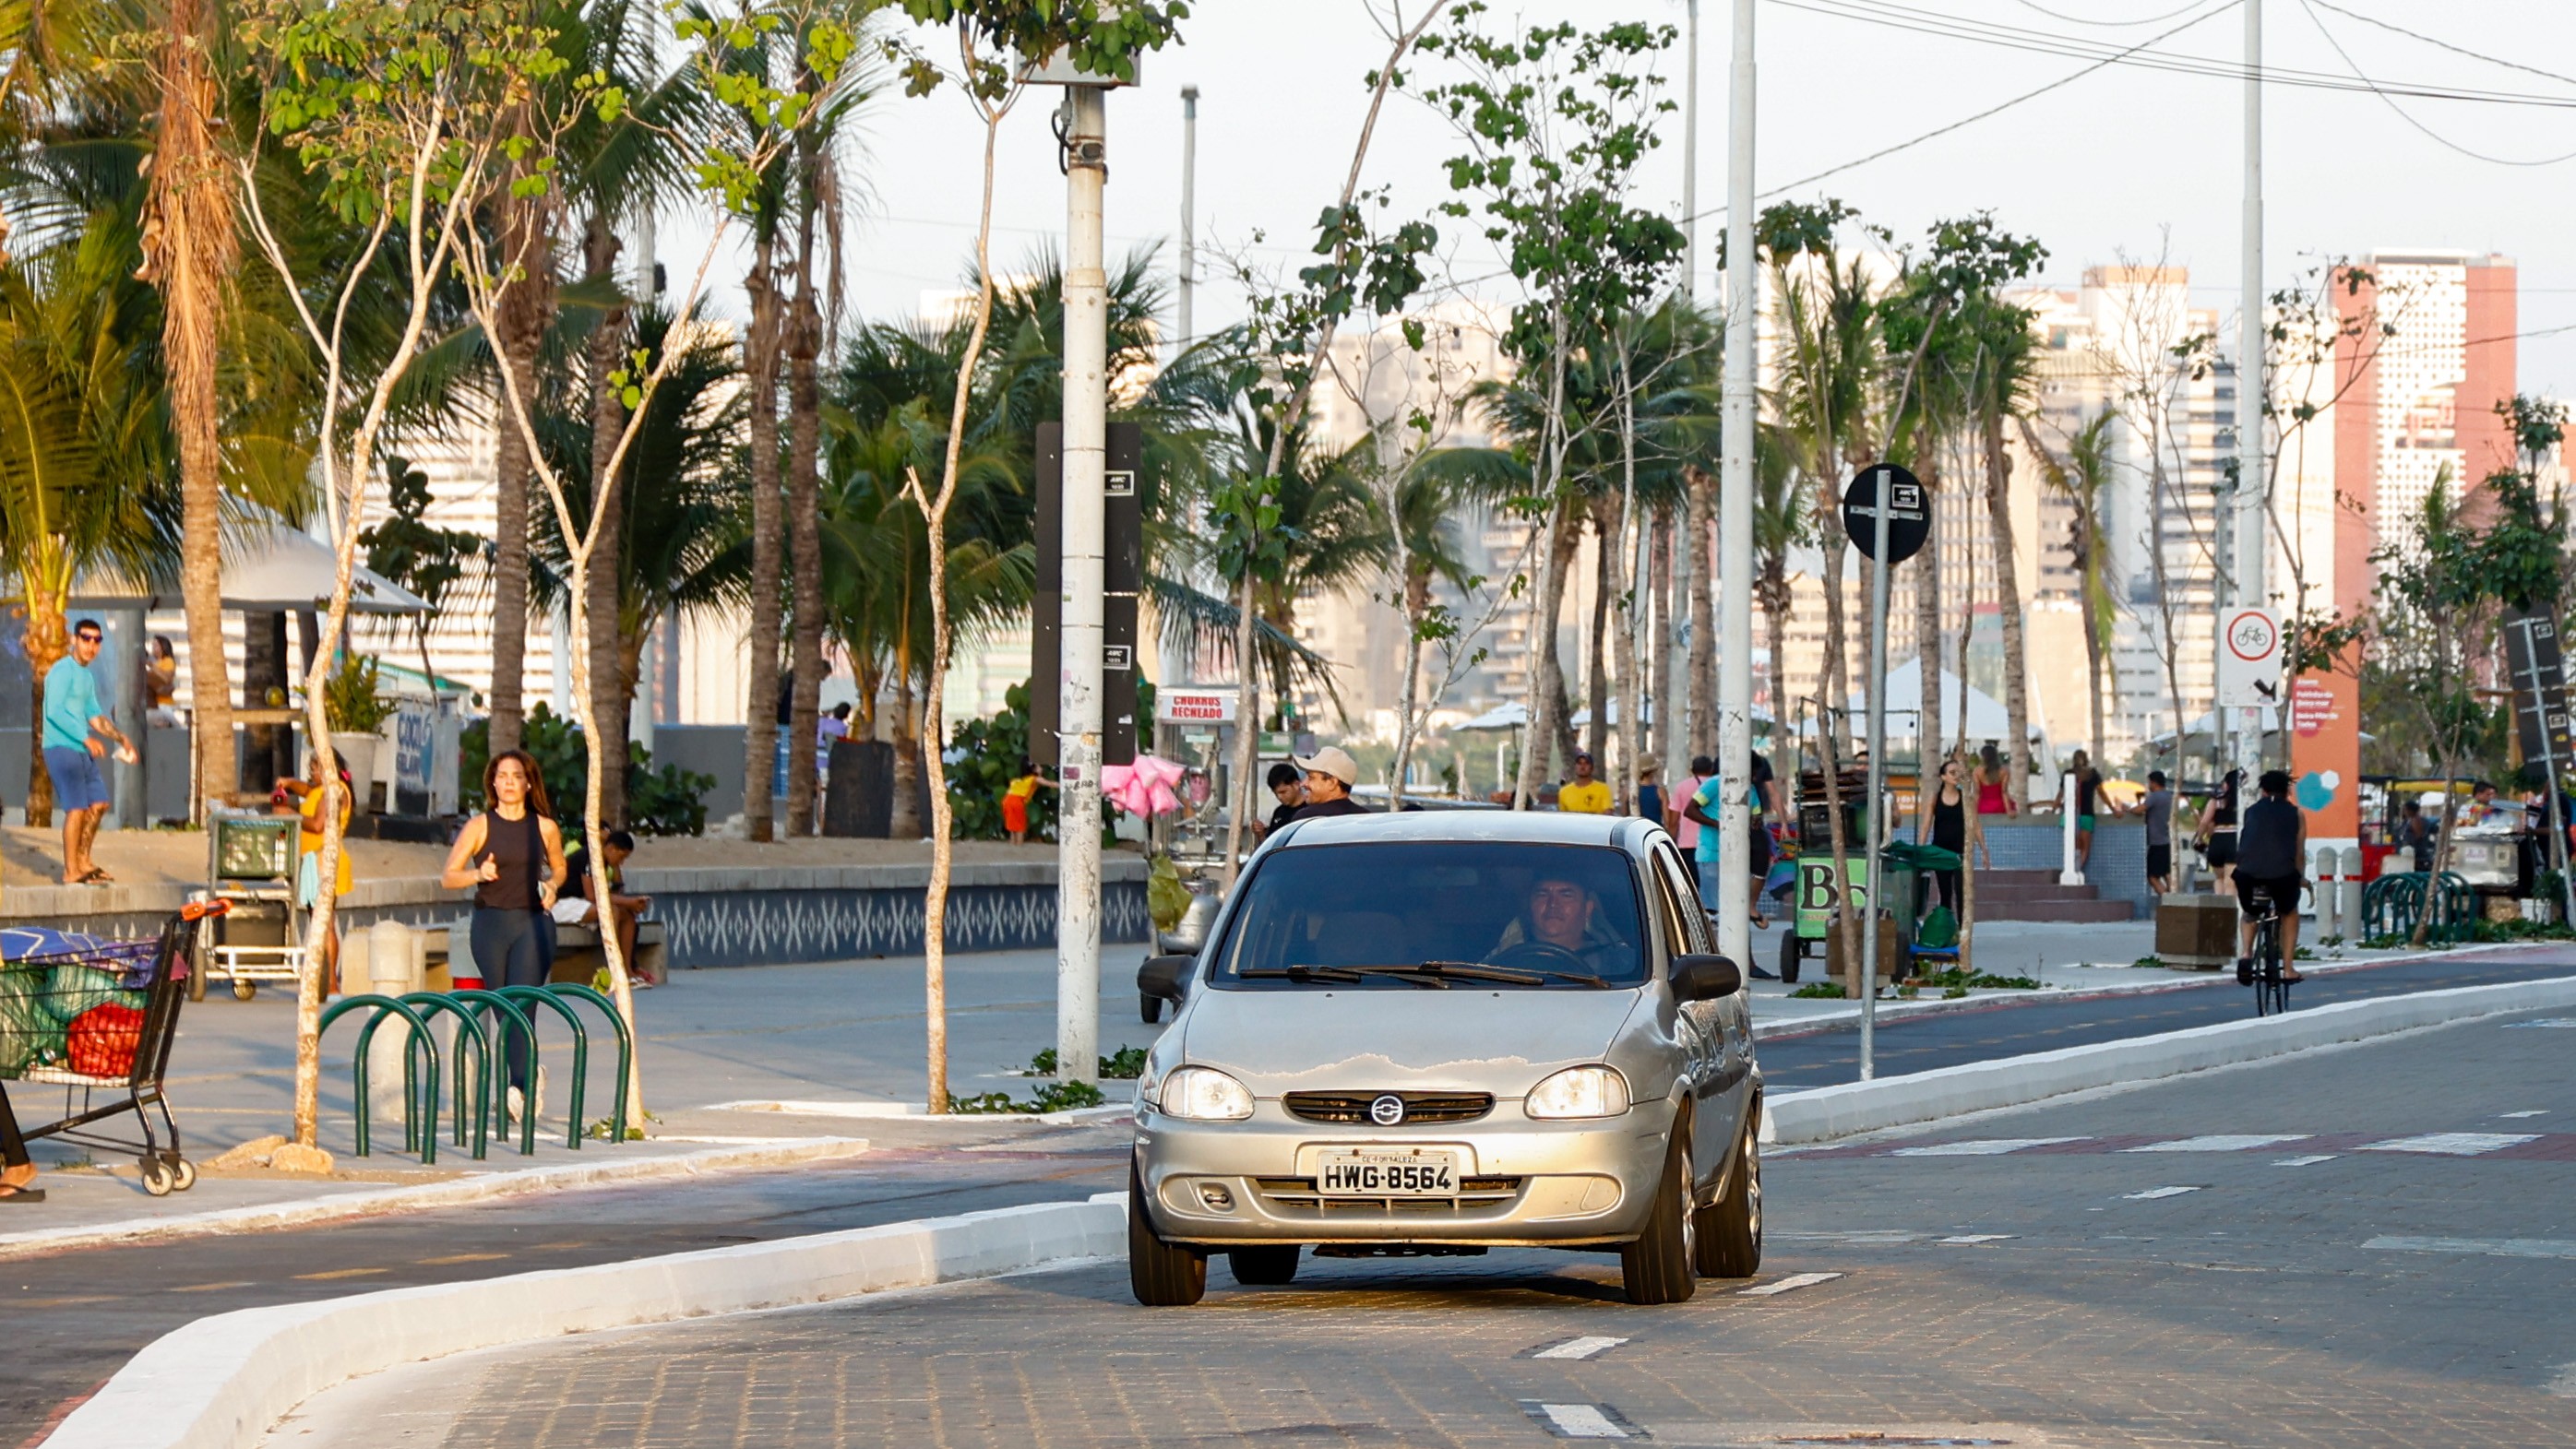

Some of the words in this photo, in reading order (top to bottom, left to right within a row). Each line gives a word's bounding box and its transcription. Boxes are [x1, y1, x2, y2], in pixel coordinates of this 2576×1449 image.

[1173, 695, 1222, 707] CHURROS
[1171, 707, 1223, 719] RECHEADO
[1325, 1165, 1452, 1190] HWG-8564
